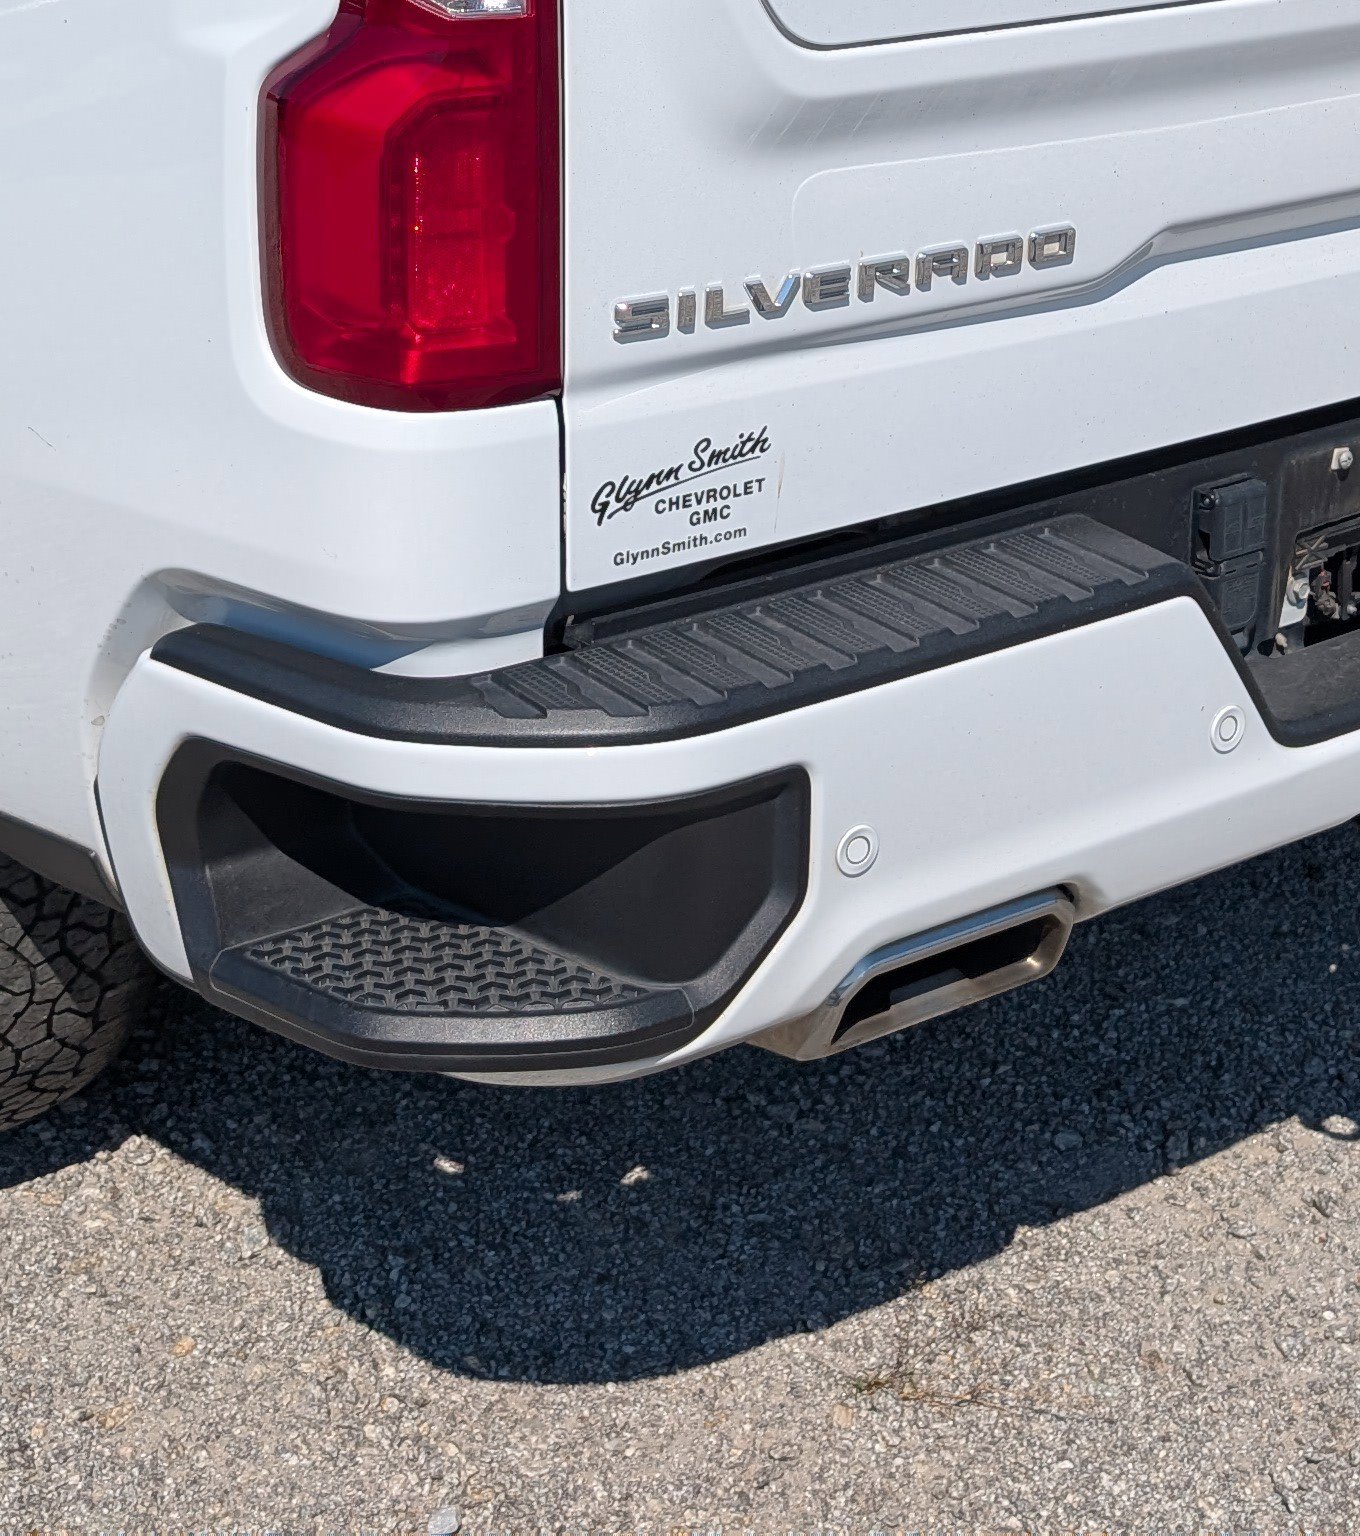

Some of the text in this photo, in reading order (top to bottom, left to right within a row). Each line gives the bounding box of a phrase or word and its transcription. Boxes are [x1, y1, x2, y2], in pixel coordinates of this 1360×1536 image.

[612, 224, 1077, 344] SILVERADO
[590, 425, 772, 526] Glynn Smith
[654, 477, 767, 515] CHEVROLET
[689, 504, 732, 527] GMC
[613, 526, 748, 566] GlynnSmith.com
